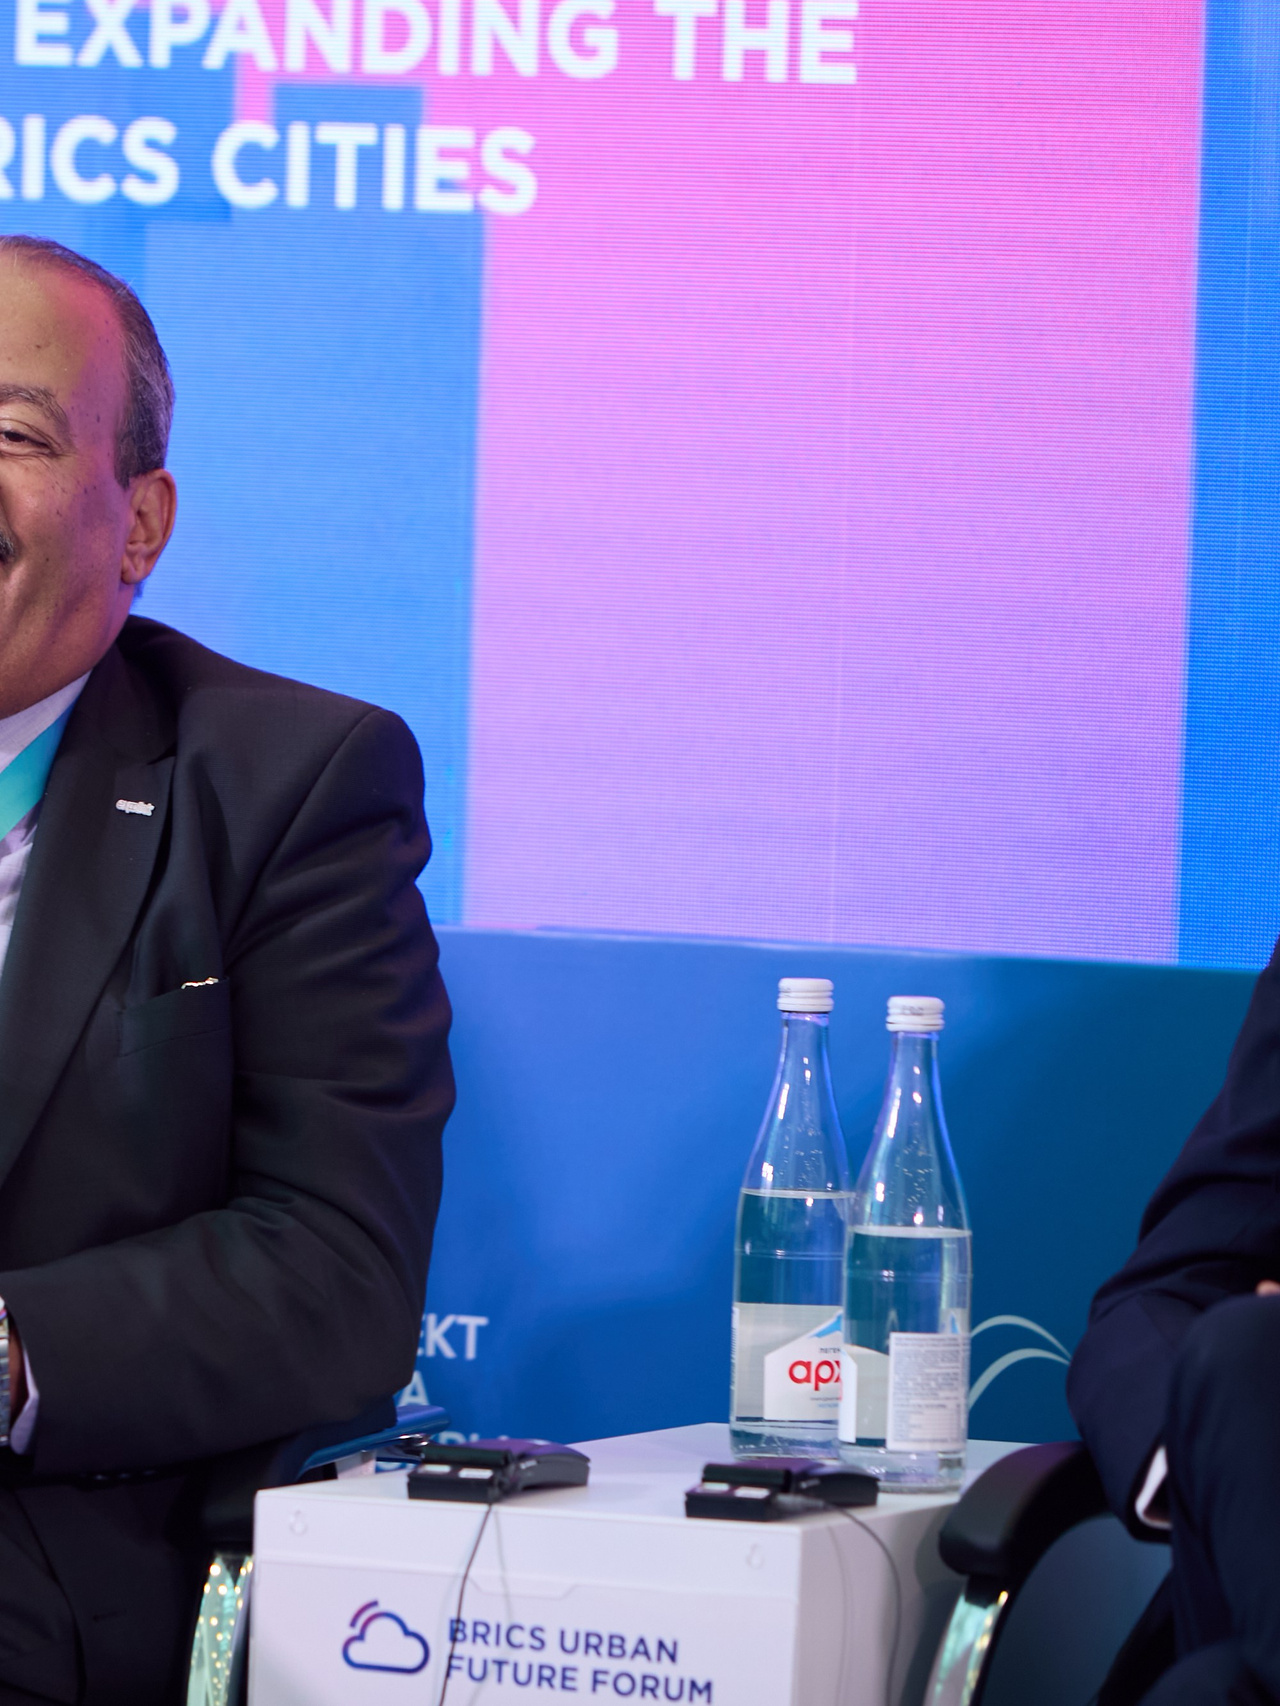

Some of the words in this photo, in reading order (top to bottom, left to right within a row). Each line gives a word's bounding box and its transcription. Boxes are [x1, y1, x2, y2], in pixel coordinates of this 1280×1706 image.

[13, 0, 622, 80] EXPANDING
[652, 0, 862, 85] THE
[210, 119, 540, 217] CITIES
[448, 1618, 547, 1652] BRICS
[559, 1629, 679, 1664] URBAN
[446, 1655, 579, 1692] FUTURE
[590, 1669, 714, 1705] FORUM
